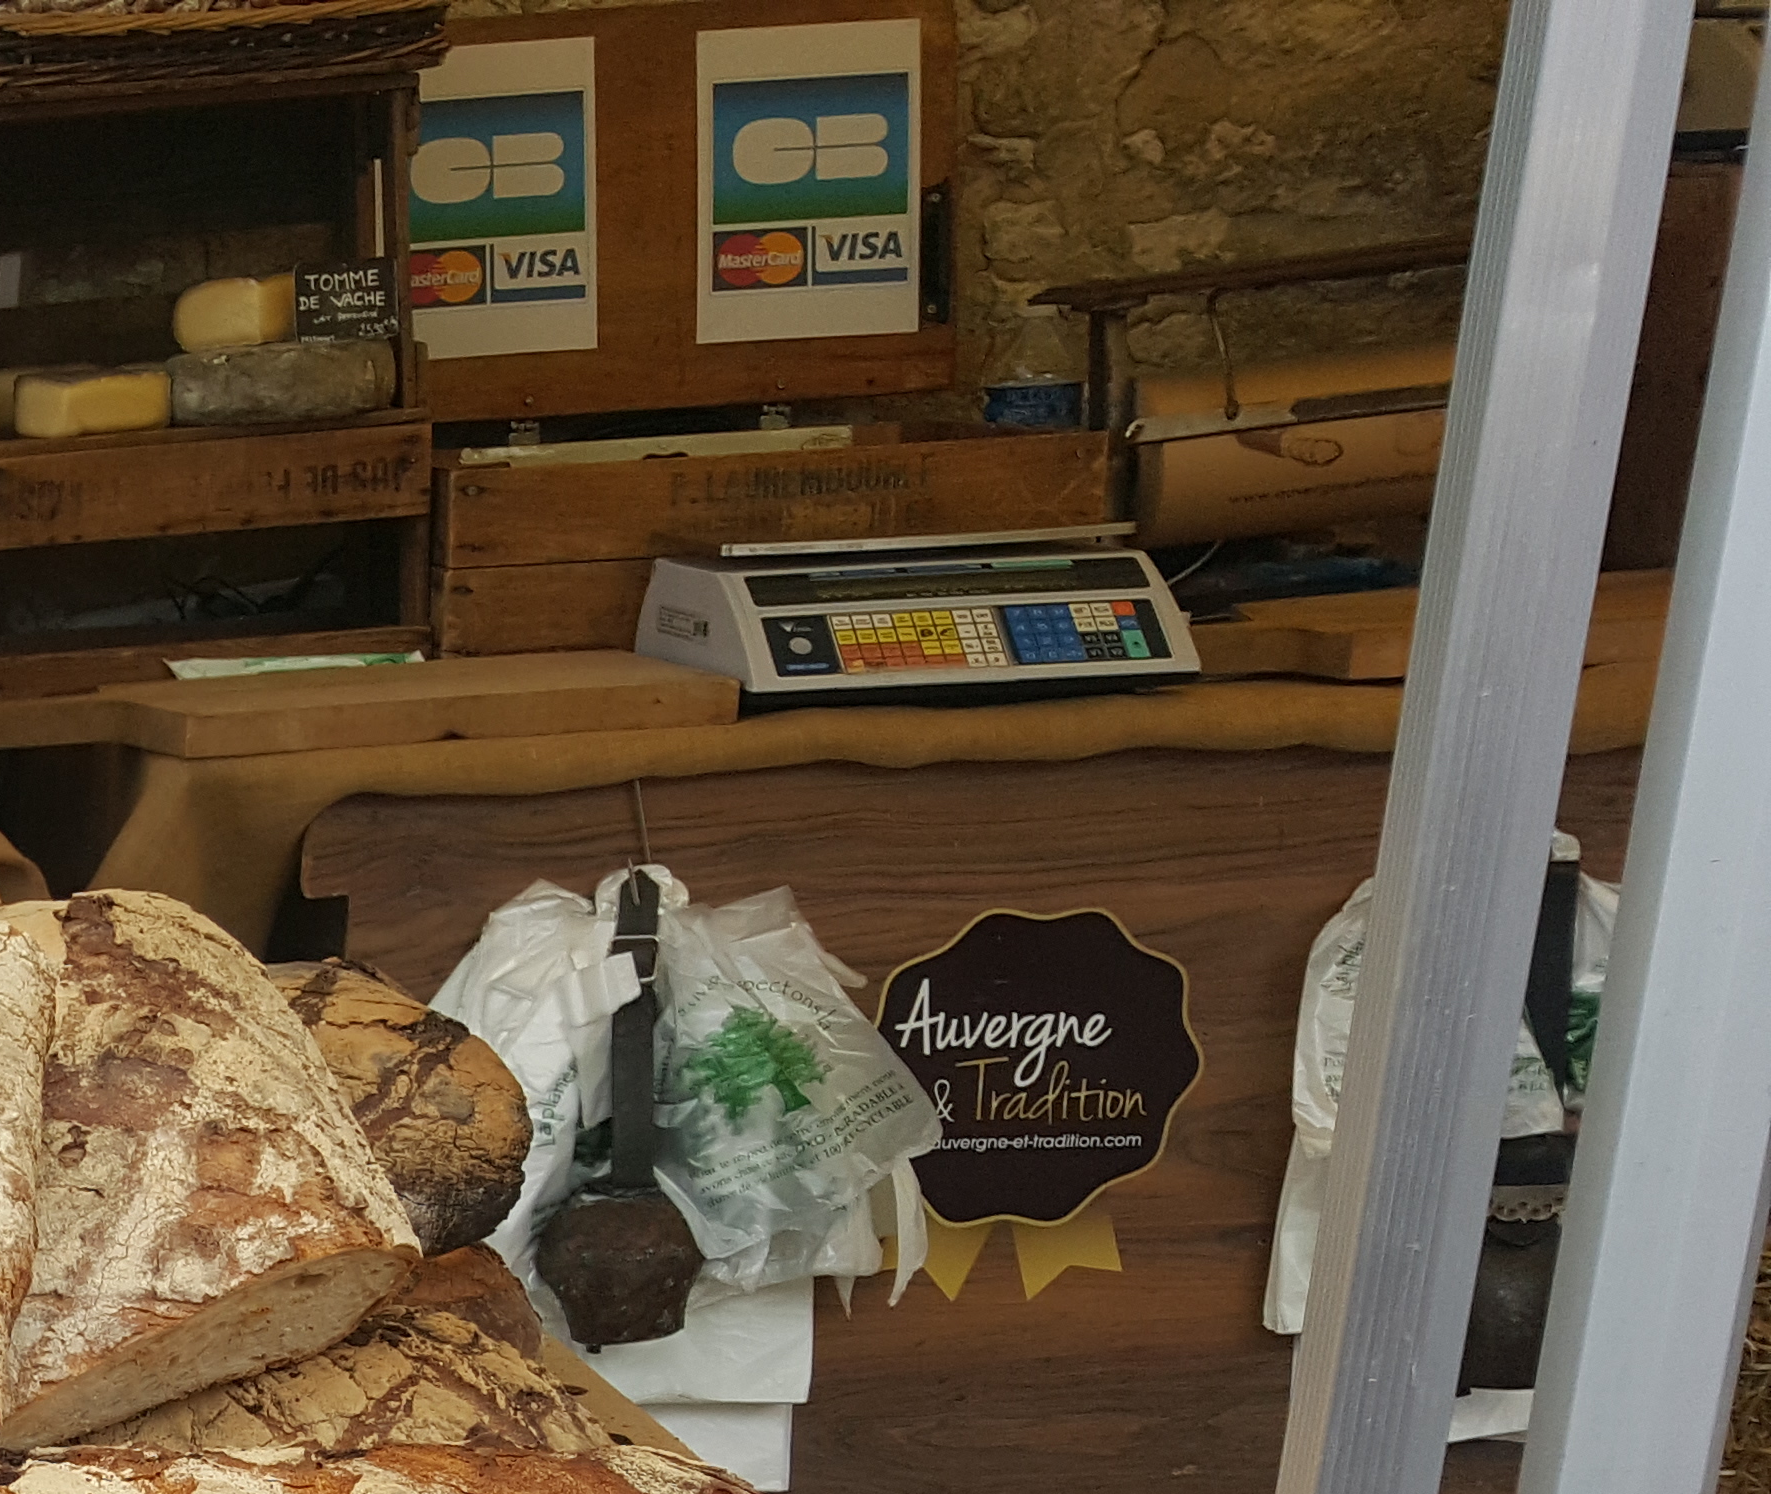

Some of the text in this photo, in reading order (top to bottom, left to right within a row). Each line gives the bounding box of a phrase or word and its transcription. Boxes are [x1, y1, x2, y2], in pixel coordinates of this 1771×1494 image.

[818, 230, 903, 262] VISA
[498, 248, 581, 279] VISA
[718, 250, 804, 269] MasterCard
[304, 269, 379, 291] TOMME
[411, 266, 481, 287] asterCard
[299, 291, 385, 310] DE VACHE
[895, 978, 1112, 1087] Auvergne
[934, 1056, 1147, 1125] & Tradition
